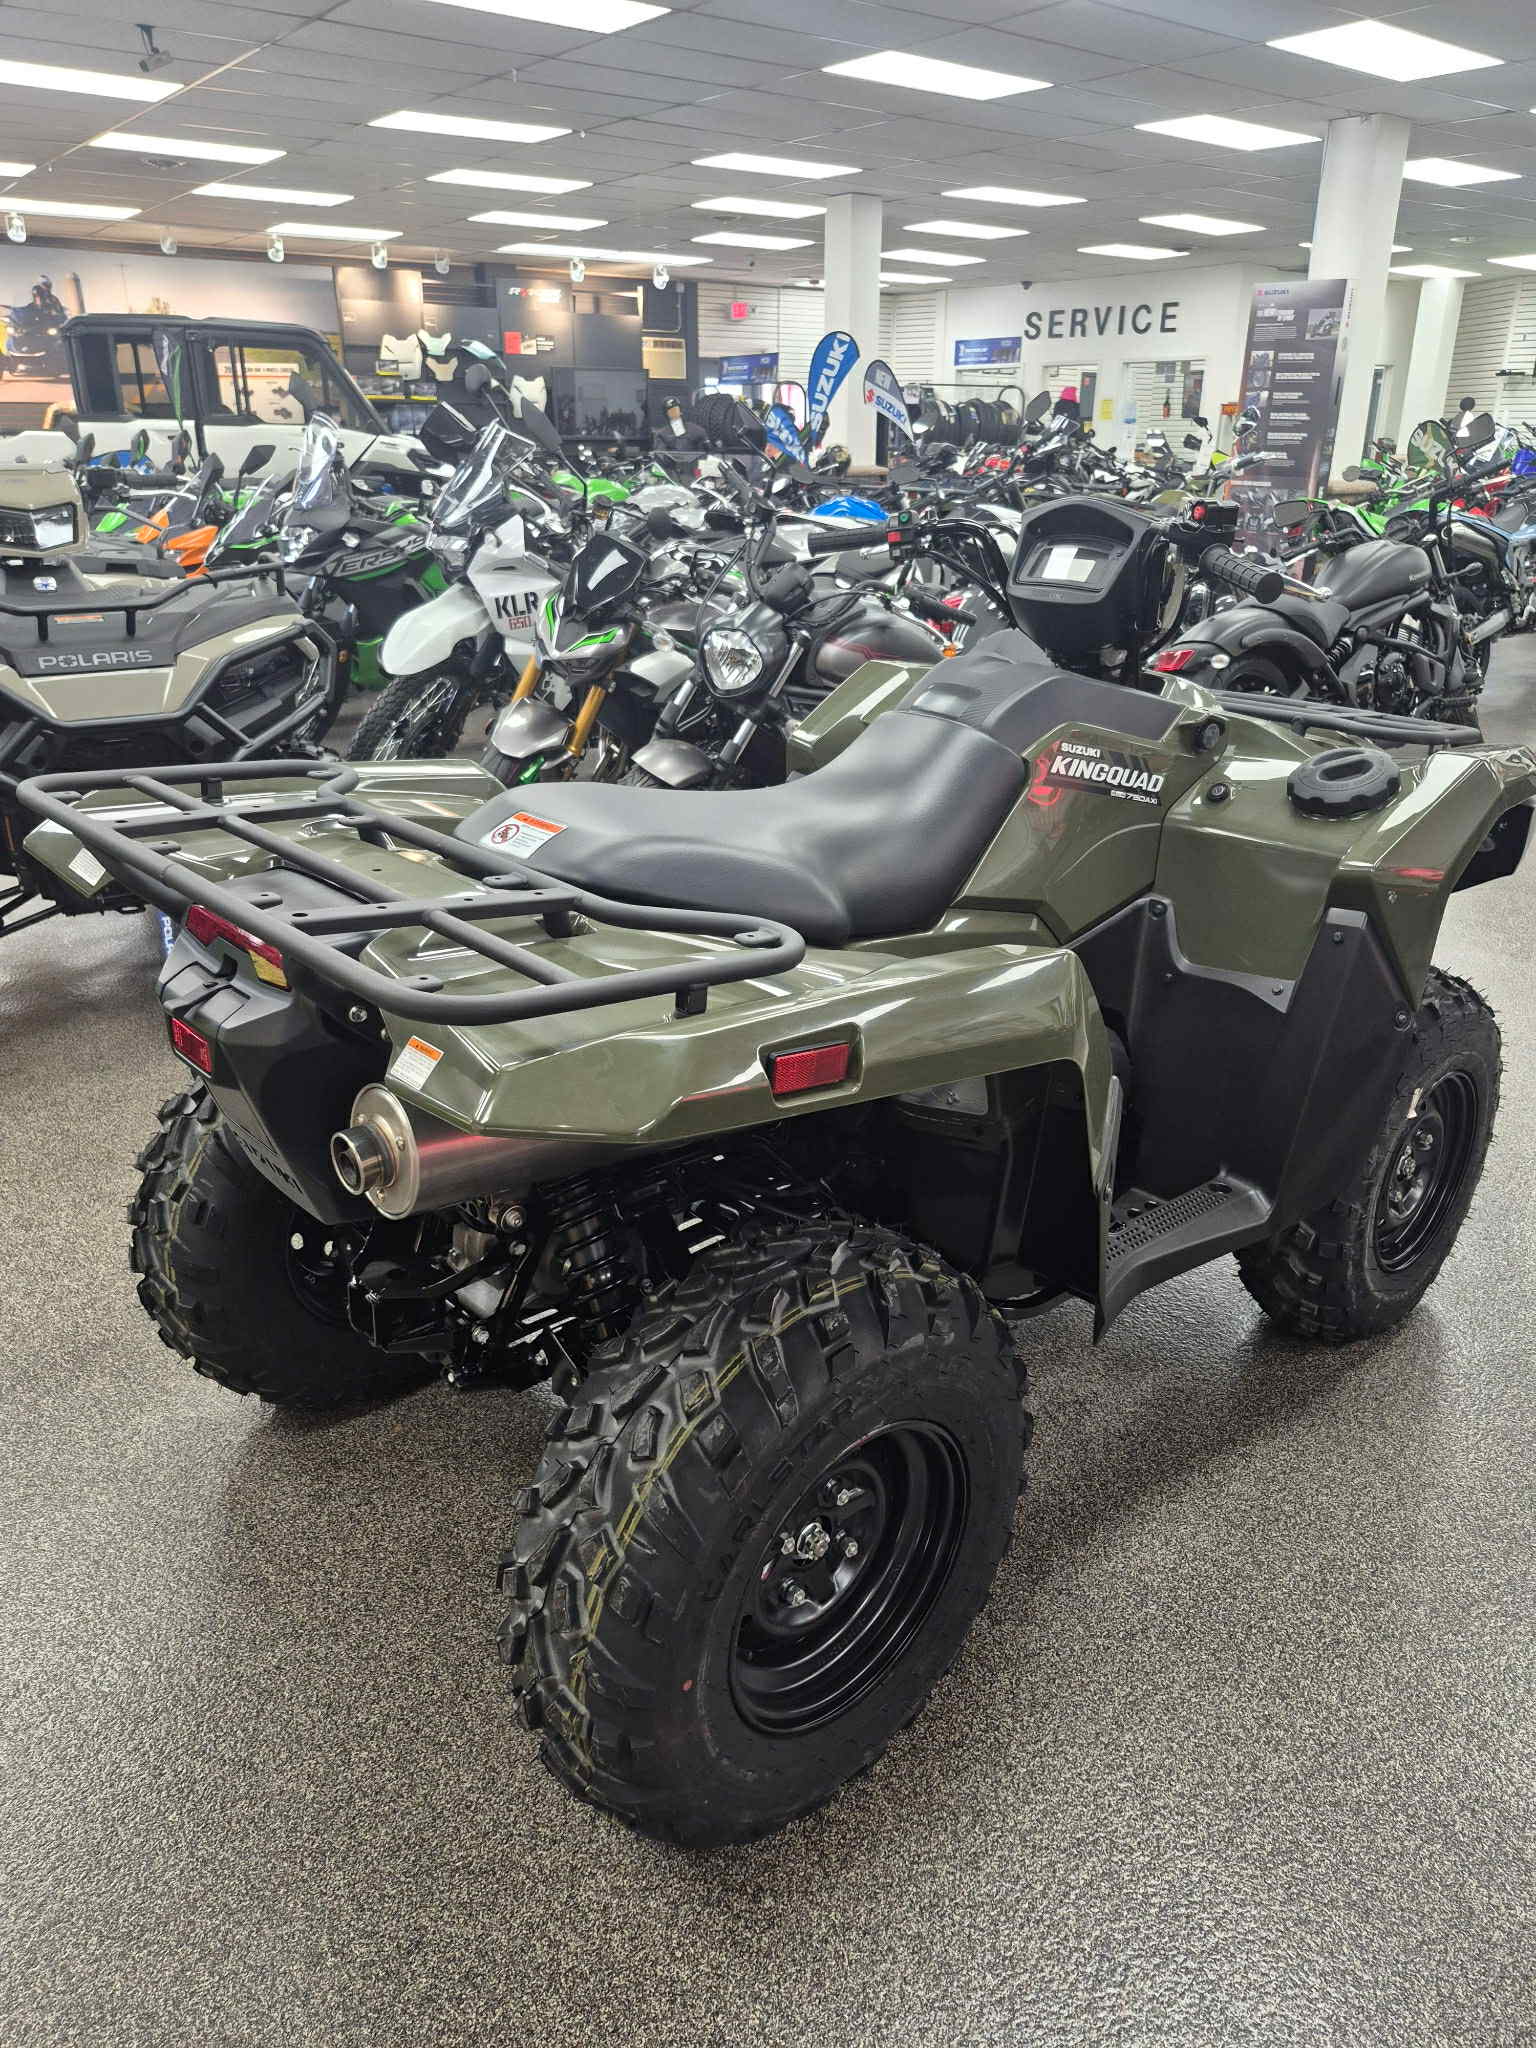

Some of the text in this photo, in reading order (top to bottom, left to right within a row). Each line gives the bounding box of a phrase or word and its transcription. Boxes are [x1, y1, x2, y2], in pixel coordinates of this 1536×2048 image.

[1024, 302, 1179, 340] SERVICE
[810, 333, 851, 433] SUZUKI
[874, 395, 907, 425] SUZUKI
[494, 592, 539, 619] KLR
[38, 650, 152, 669] POLARIS
[1060, 742, 1101, 758] SUZUKI
[1051, 755, 1164, 793] KINGQUAD
